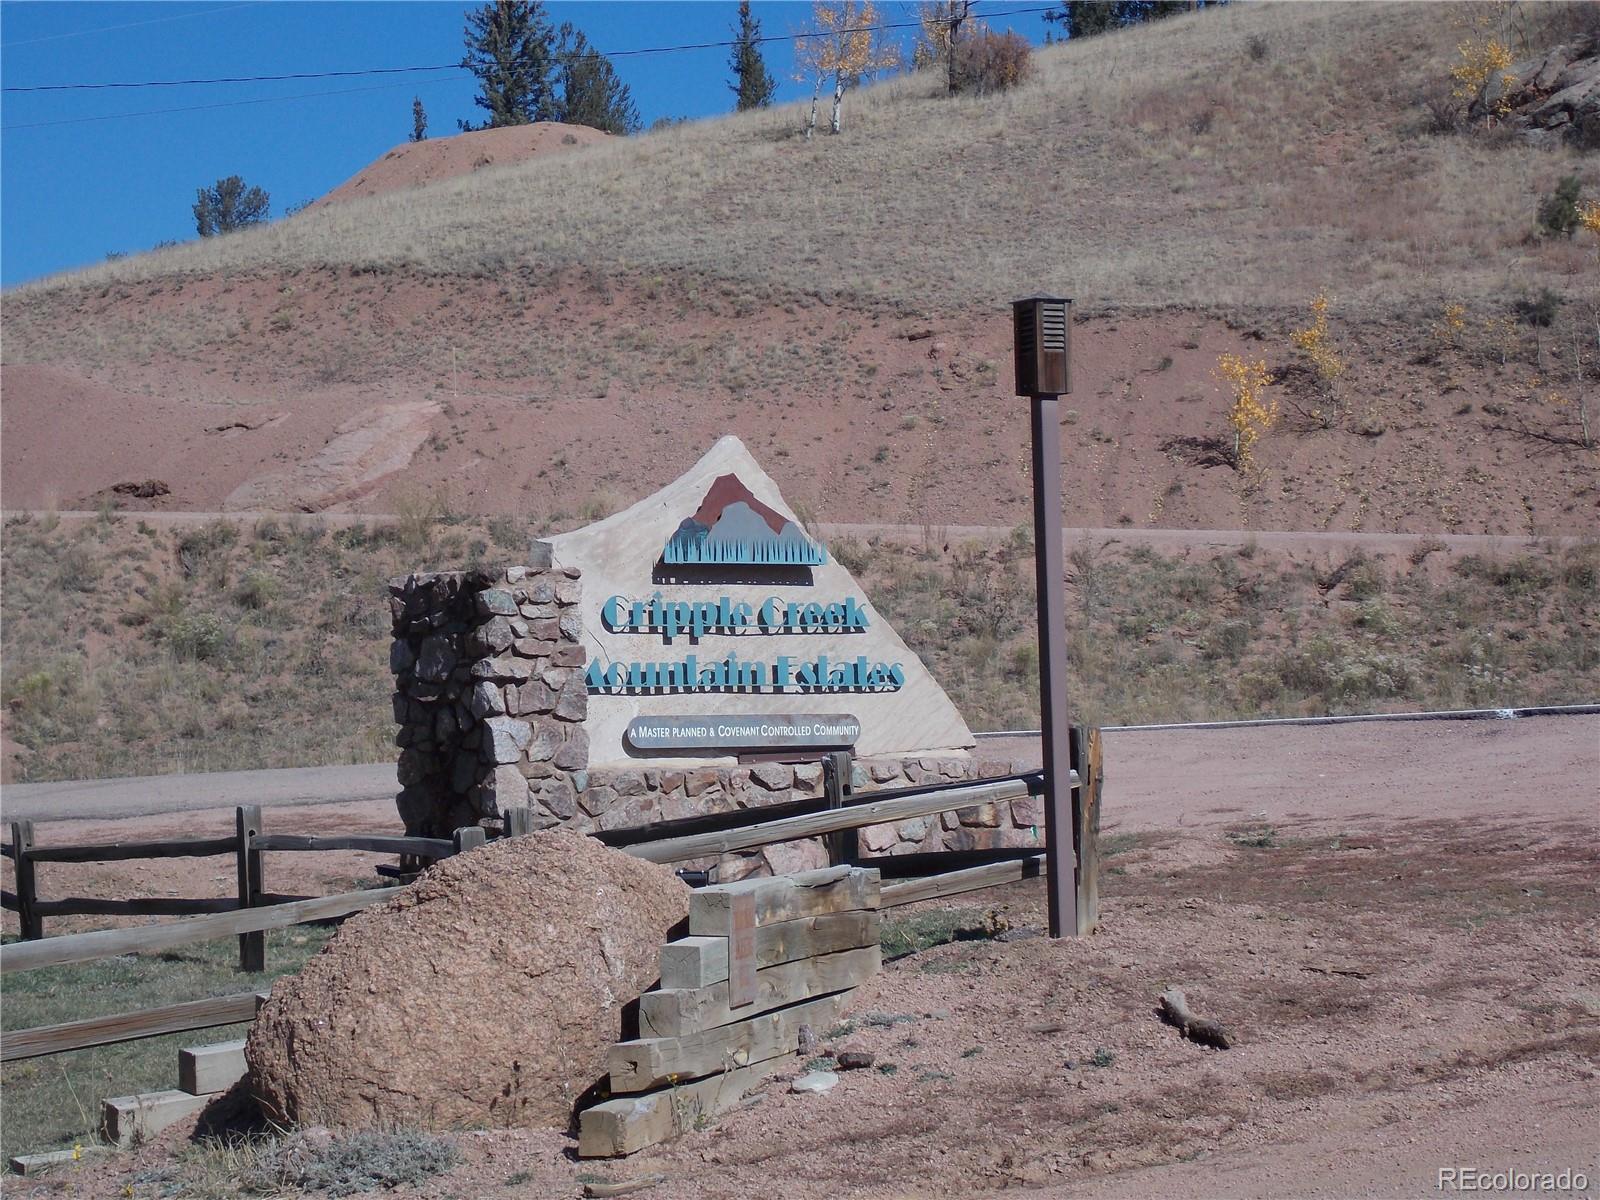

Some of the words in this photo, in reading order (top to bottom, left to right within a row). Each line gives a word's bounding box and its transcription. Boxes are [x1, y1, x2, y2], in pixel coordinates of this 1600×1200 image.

[602, 591, 753, 638] Cripple
[760, 596, 871, 630] Creek
[775, 655, 905, 688] Estates
[630, 727, 637, 738] A
[638, 726, 670, 738] MASTER
[672, 727, 707, 738] PLANNED
[709, 727, 715, 737] &
[718, 725, 759, 737] COVENANT
[760, 724, 811, 736] CONTROLLED
[813, 723, 859, 736] COMMUNITY
